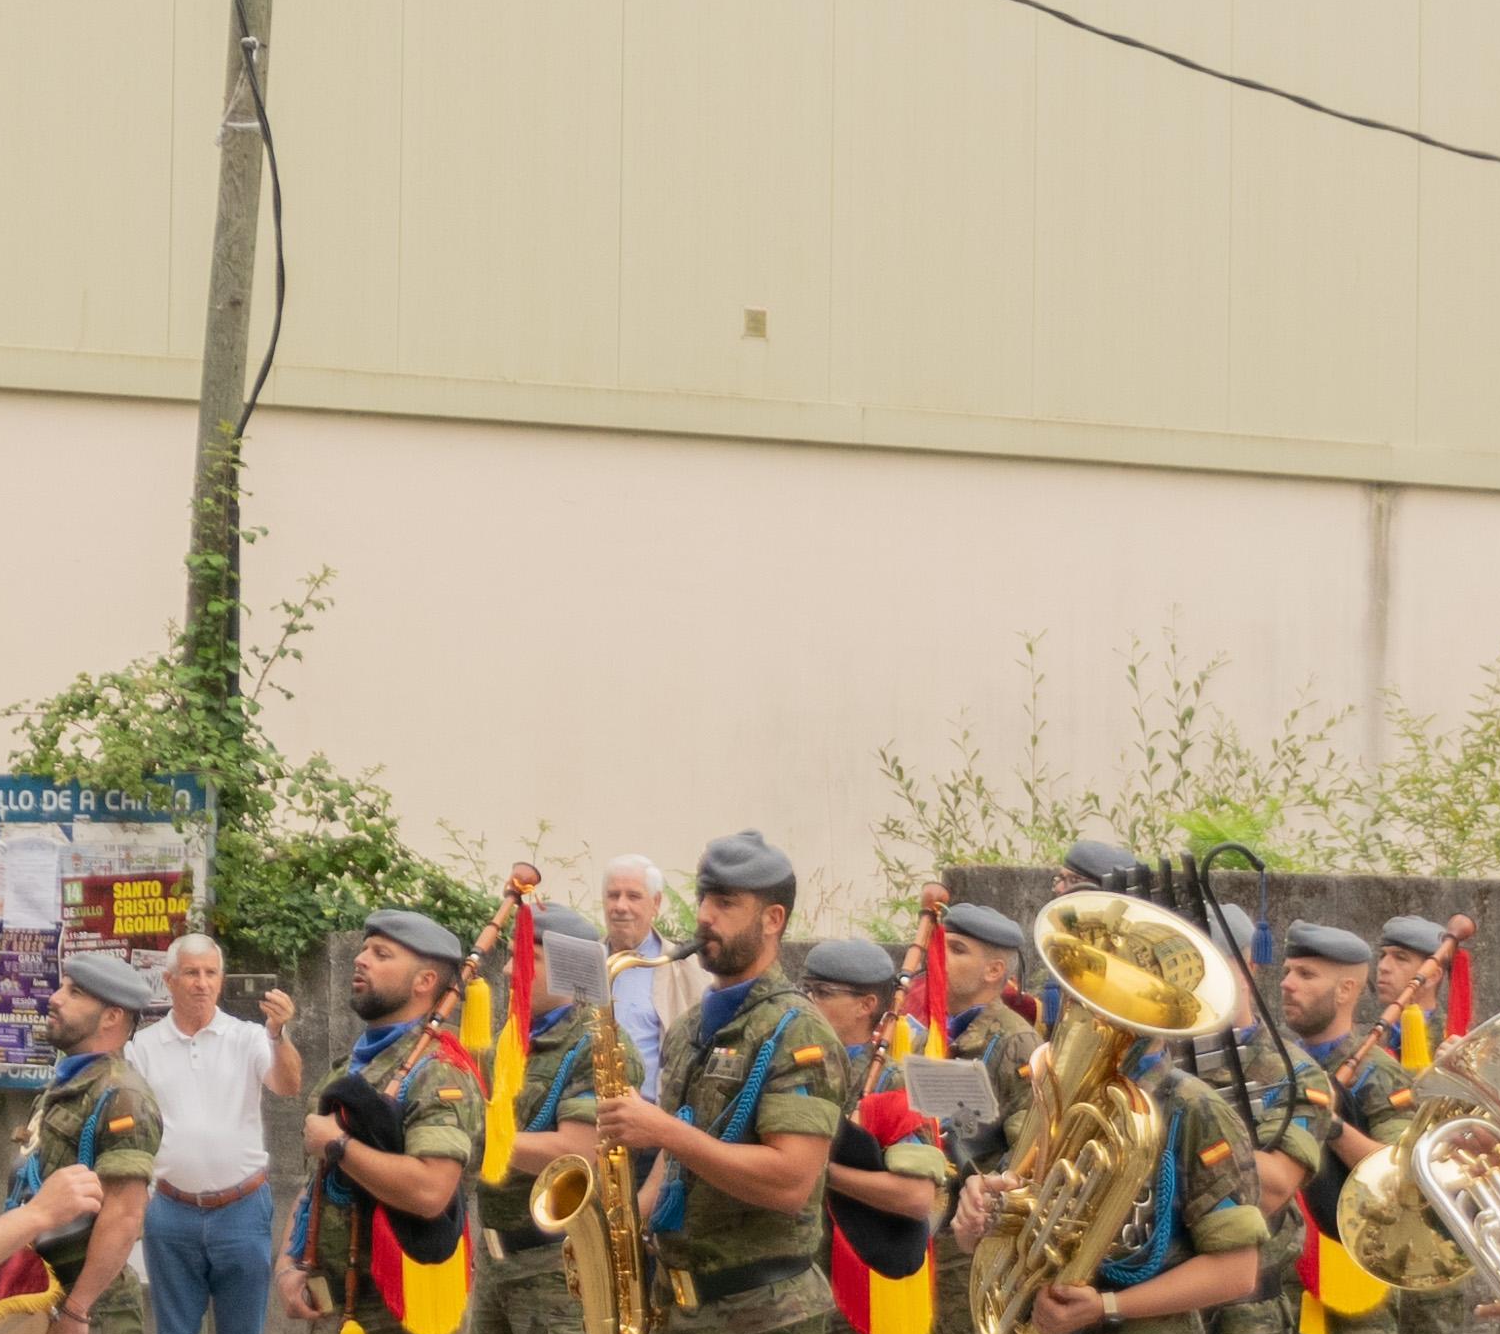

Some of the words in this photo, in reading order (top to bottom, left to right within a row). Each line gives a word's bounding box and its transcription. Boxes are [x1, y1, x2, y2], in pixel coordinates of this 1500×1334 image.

[42, 789, 73, 811] DE
[79, 789, 96, 811] A
[64, 882, 83, 903] 14
[112, 880, 162, 899] SANTO
[112, 898, 166, 917] CRISTO
[167, 897, 188, 915] DA
[112, 914, 171, 934] AGONÍA
